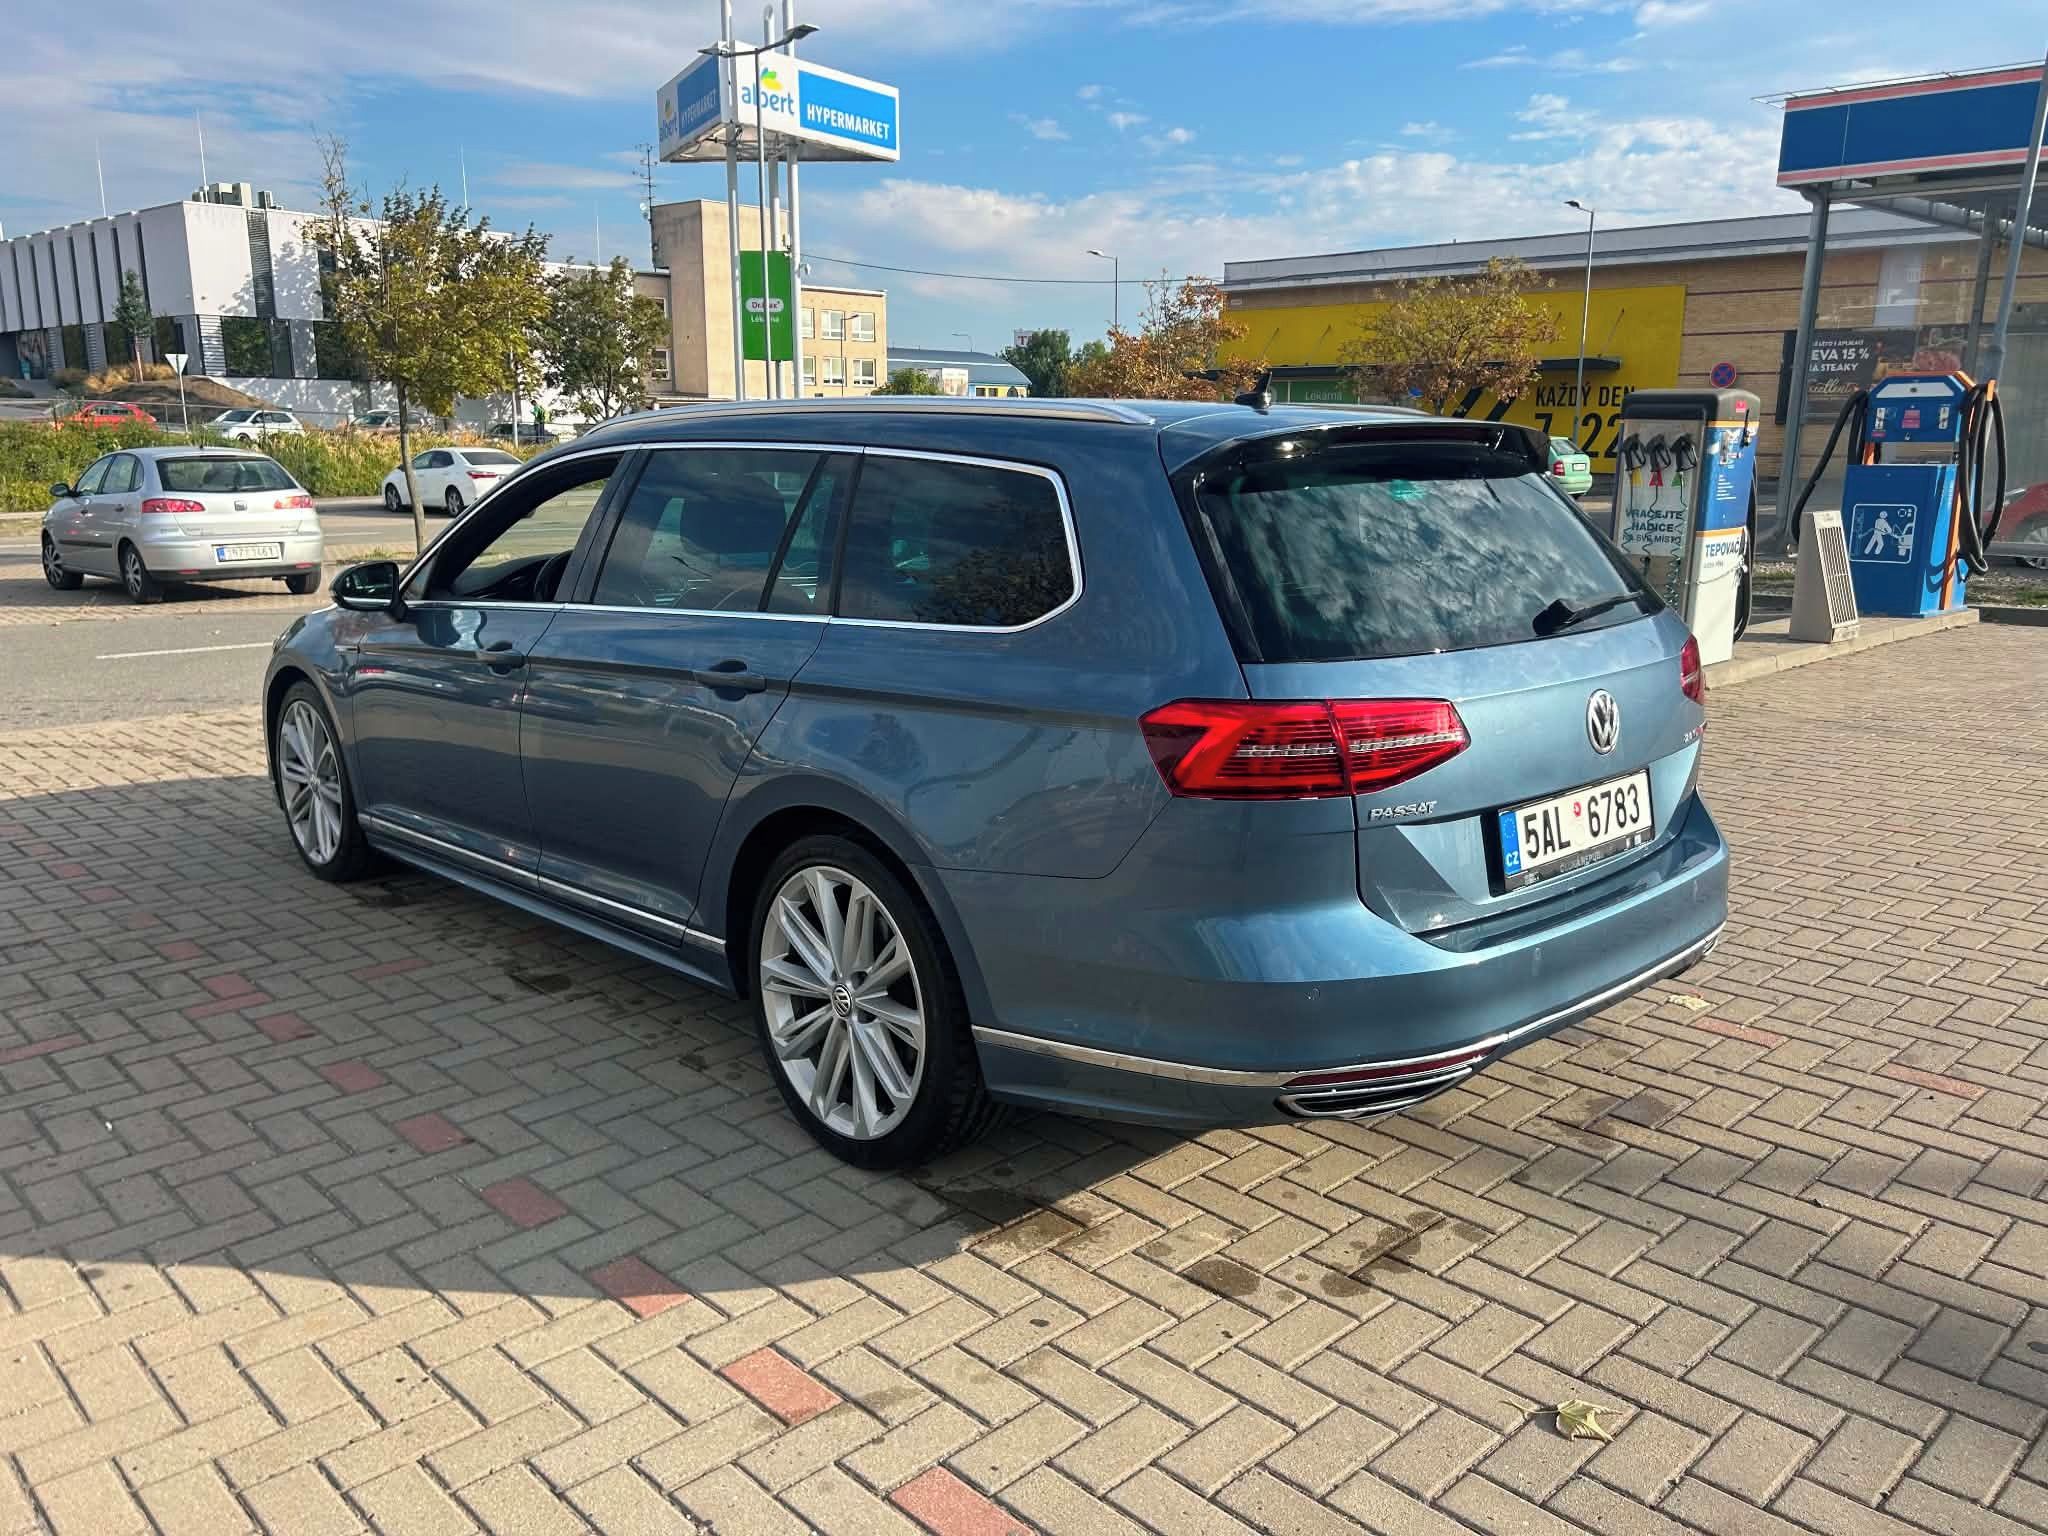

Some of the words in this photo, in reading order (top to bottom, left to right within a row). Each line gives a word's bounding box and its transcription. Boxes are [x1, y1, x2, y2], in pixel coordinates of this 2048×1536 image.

[806, 103, 891, 140] HYPERMARKET
[1811, 348, 1838, 361] EVA
[1841, 348, 1856, 360] 15
[1858, 347, 1870, 360] %
[1820, 362, 1859, 373] STEAKY
[1536, 381, 1591, 407] KAŽDÝ
[1368, 800, 1438, 820] PASSAT
[1523, 805, 1570, 859] 5AL
[1587, 784, 1640, 838] 6783
[1505, 850, 1520, 867] CZ
